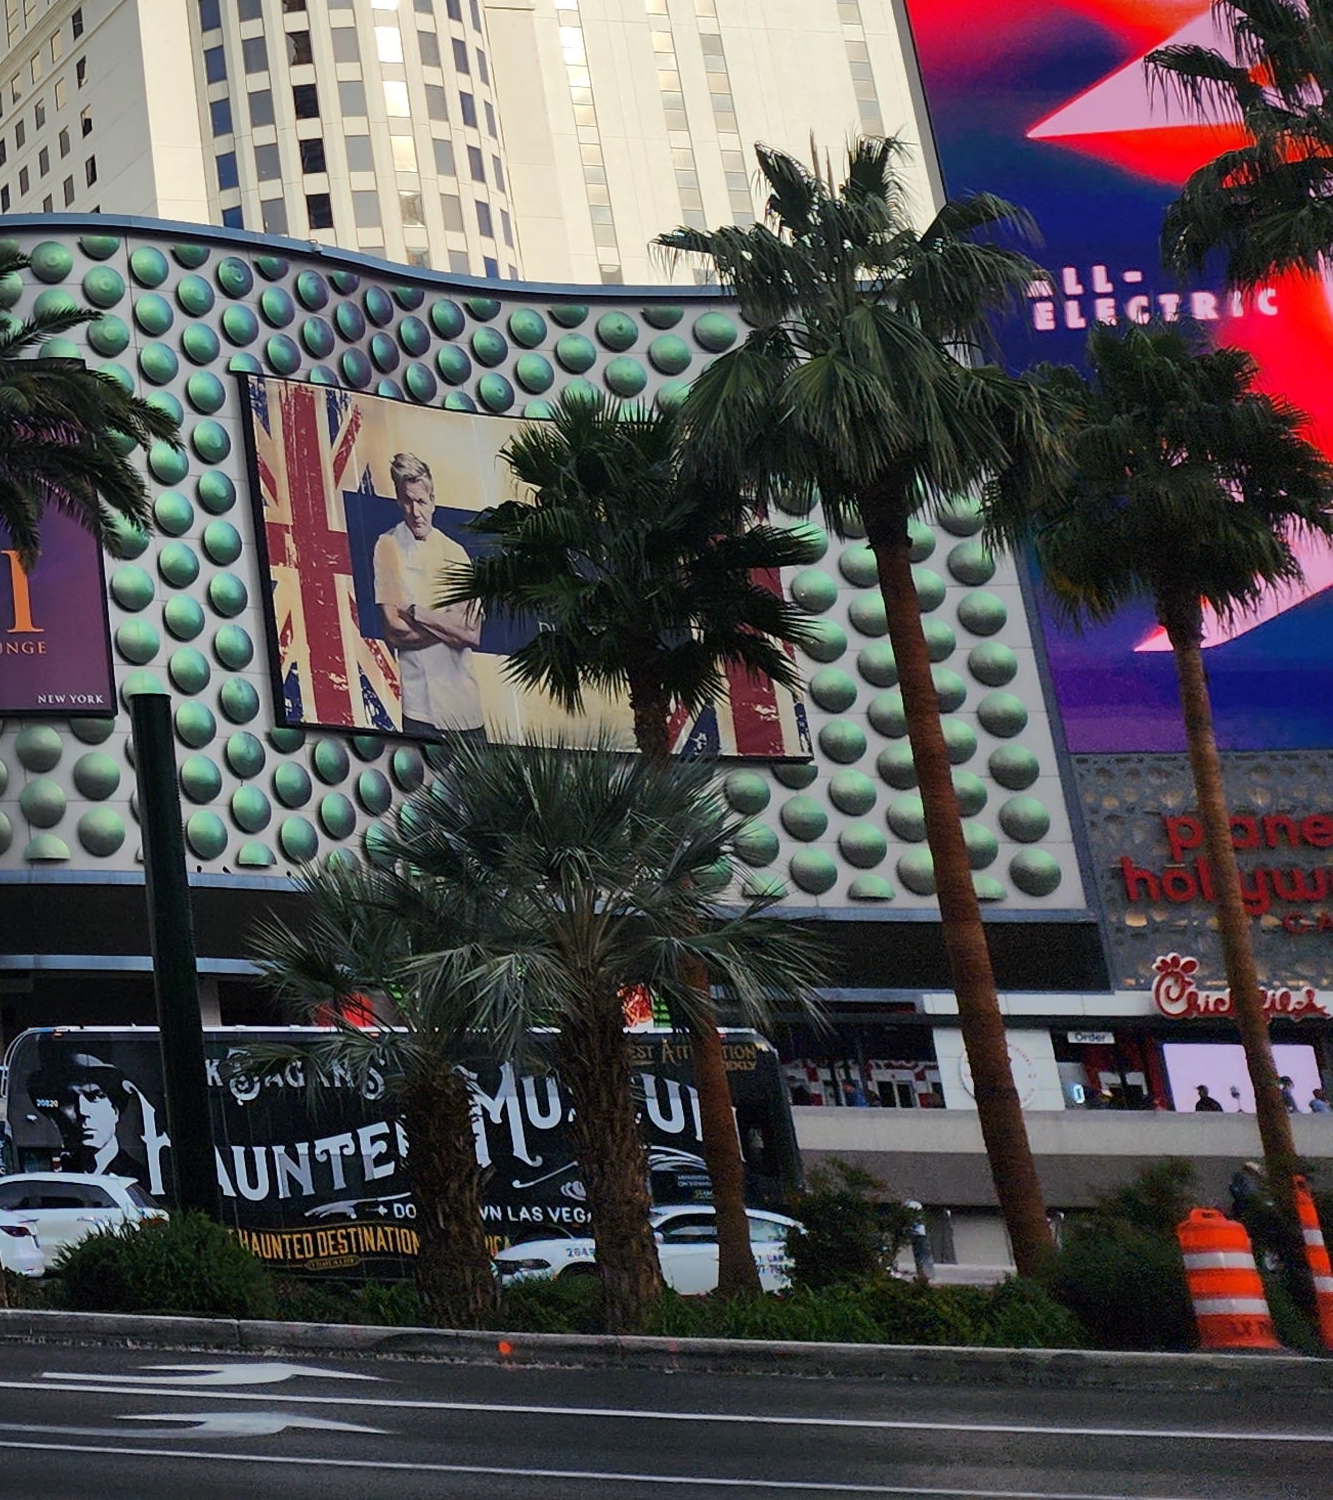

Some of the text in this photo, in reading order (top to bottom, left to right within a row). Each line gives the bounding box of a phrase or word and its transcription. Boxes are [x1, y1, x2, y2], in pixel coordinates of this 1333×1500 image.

[1034, 287, 1279, 331] ELECTRIC
[38, 694, 105, 705] NEW YORK
[1165, 814, 1333, 862] pane
[507, 1205, 544, 1222] LAS
[546, 1206, 592, 1223] VEG
[239, 1229, 313, 1259] HAUNTED
[317, 1225, 421, 1257] DESTINATION
